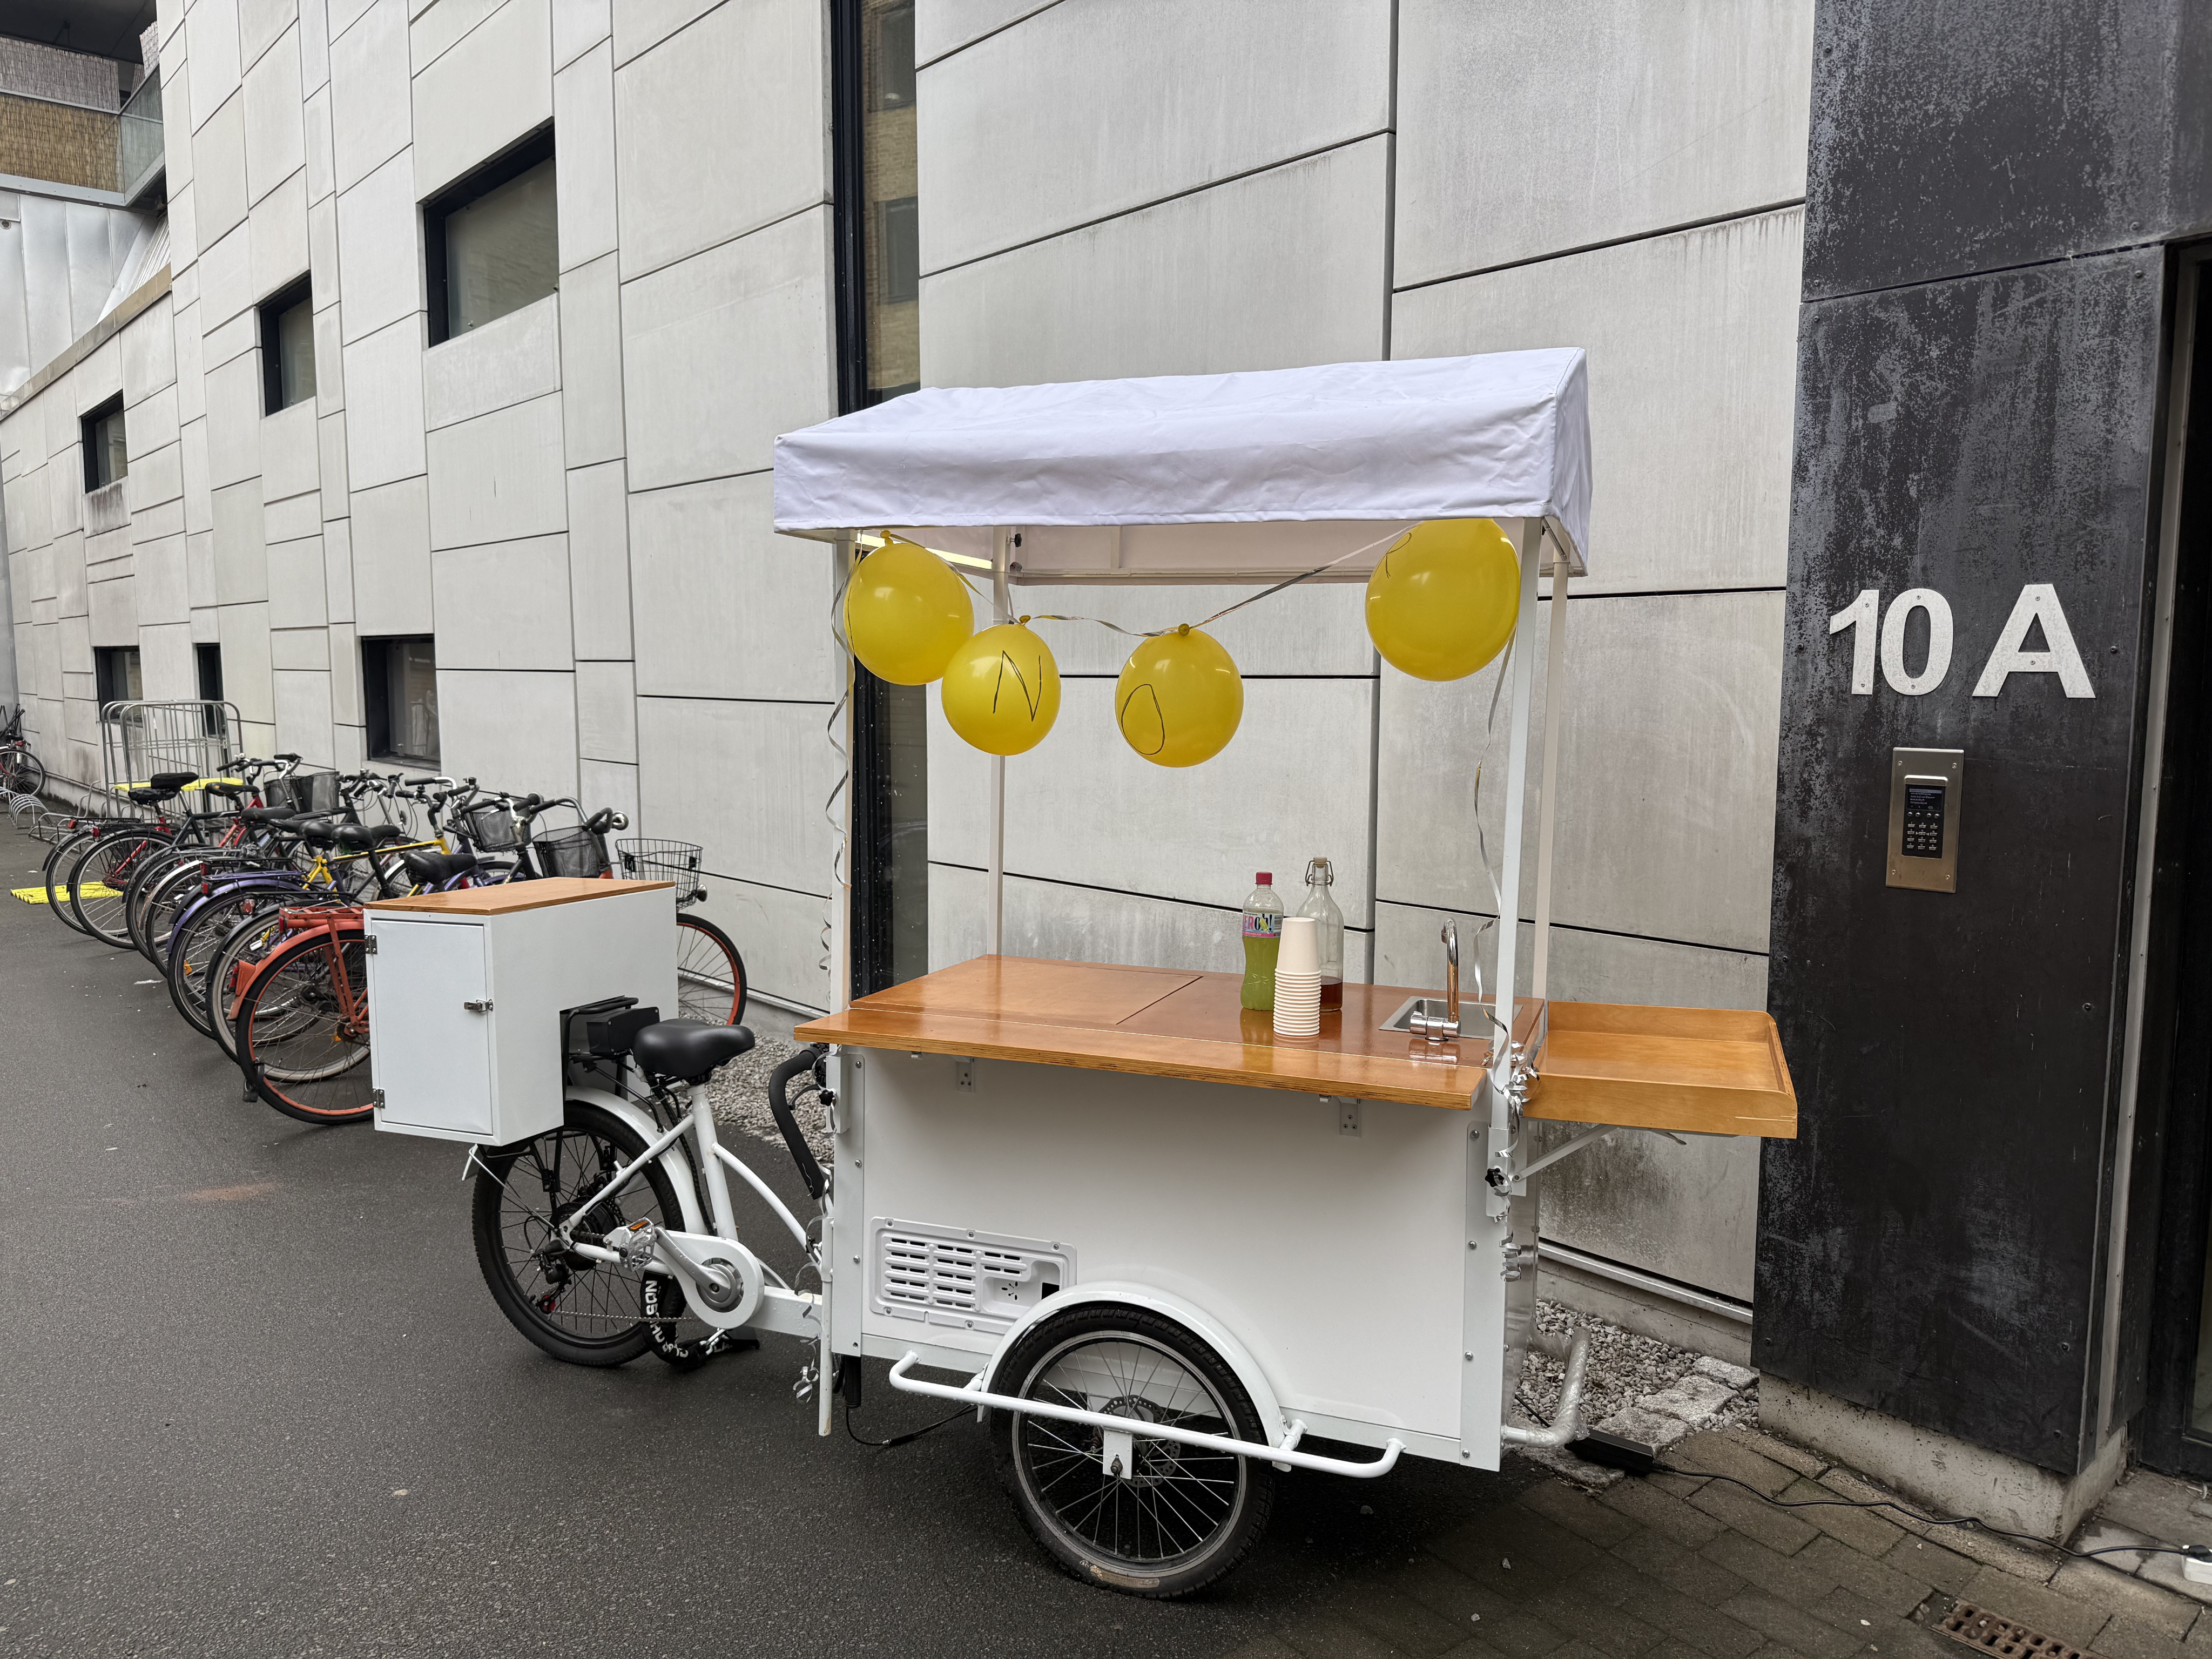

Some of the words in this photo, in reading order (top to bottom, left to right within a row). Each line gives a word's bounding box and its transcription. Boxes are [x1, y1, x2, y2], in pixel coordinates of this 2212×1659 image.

[993, 650, 1042, 722] N
[1829, 588, 1954, 696] 10
[1972, 583, 2096, 698] A
